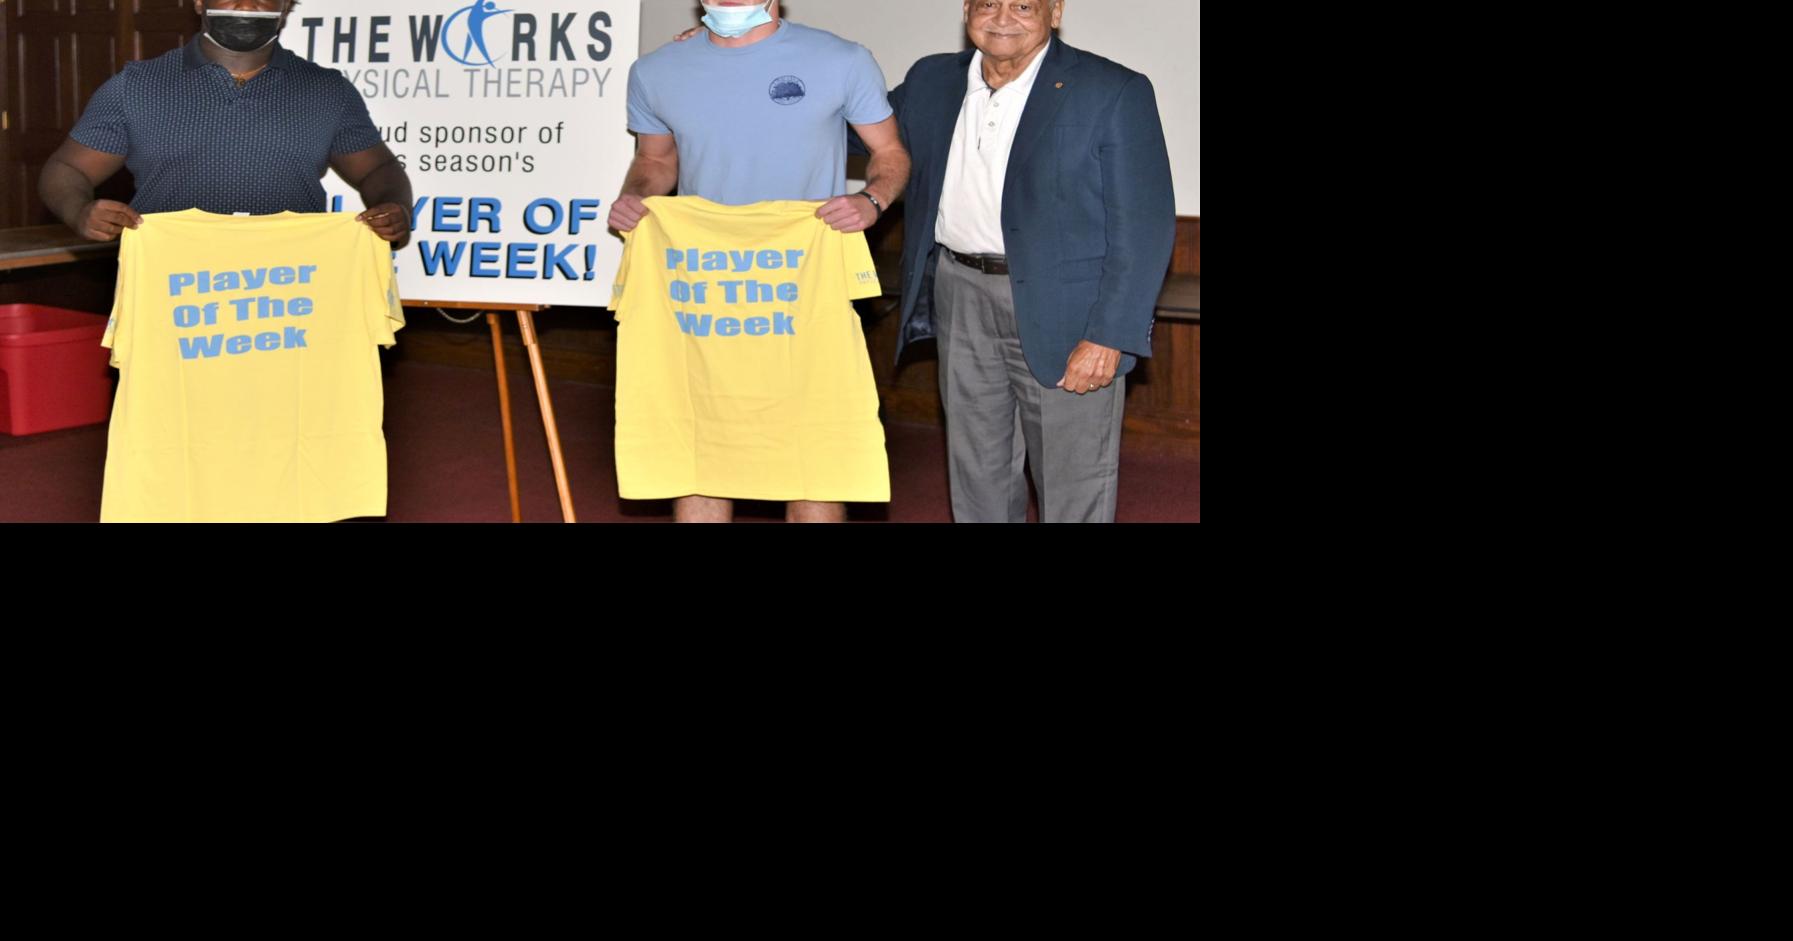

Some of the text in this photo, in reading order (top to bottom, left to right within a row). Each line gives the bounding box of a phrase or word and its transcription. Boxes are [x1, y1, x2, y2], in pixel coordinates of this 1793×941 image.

[302, 16, 391, 63] THE
[343, 68, 613, 98] YSICAL THERAPY
[419, 125, 527, 148] sponsor
[538, 122, 564, 143] of
[419, 152, 535, 173] season's
[523, 197, 601, 235] OF
[418, 240, 597, 281] WEEK!
[666, 248, 805, 272] Player
[168, 265, 317, 296] Player
[669, 280, 799, 304] Of The
[173, 296, 313, 328] Of The
[675, 311, 796, 337] Week
[178, 326, 307, 360] Week
